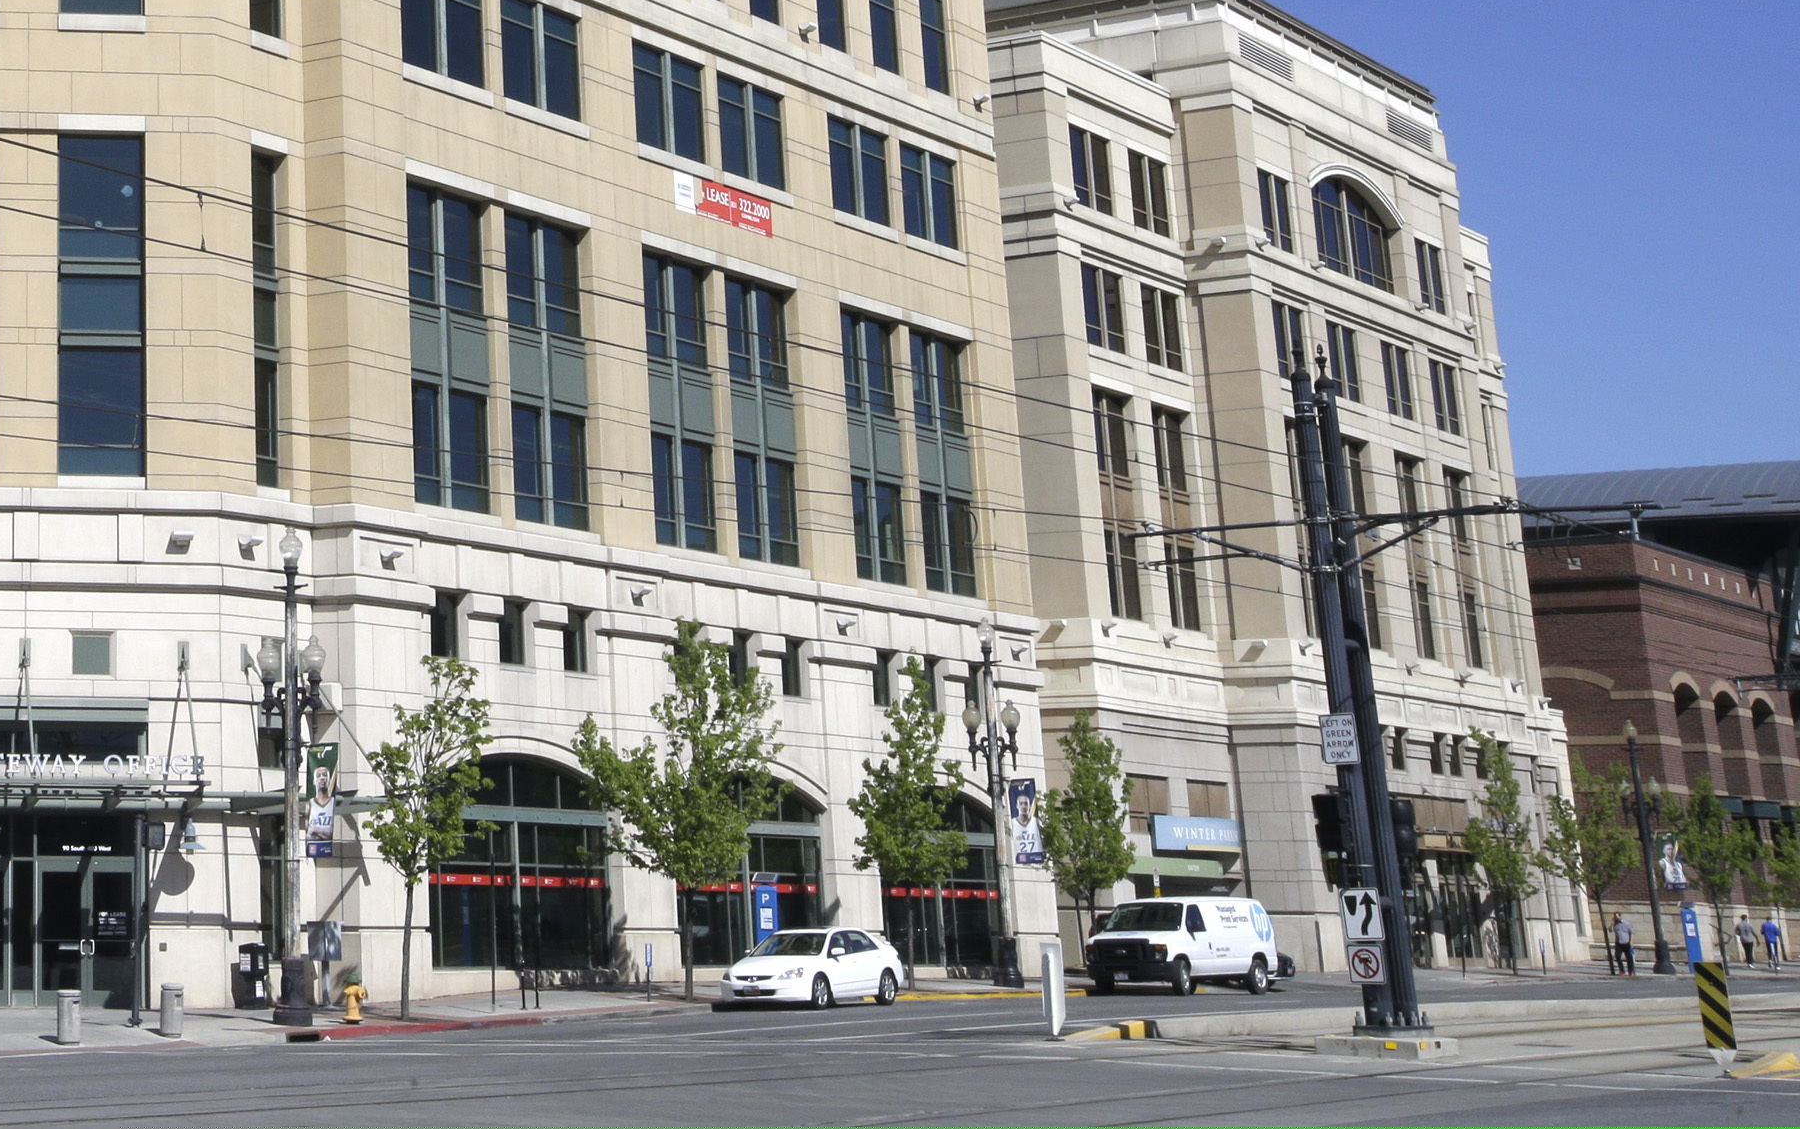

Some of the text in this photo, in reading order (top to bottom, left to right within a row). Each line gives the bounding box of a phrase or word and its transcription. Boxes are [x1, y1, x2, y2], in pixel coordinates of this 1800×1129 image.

[706, 187, 730, 207] LEASE
[1322, 718, 1353, 727] LEFT ON
[1326, 740, 1354, 748] ARROW
[1330, 751, 1351, 759] ONLY
[103, 754, 205, 775] OFFICE
[1173, 826, 1216, 840] WINTER
[1019, 841, 1035, 852] 27
[761, 893, 770, 904] P
